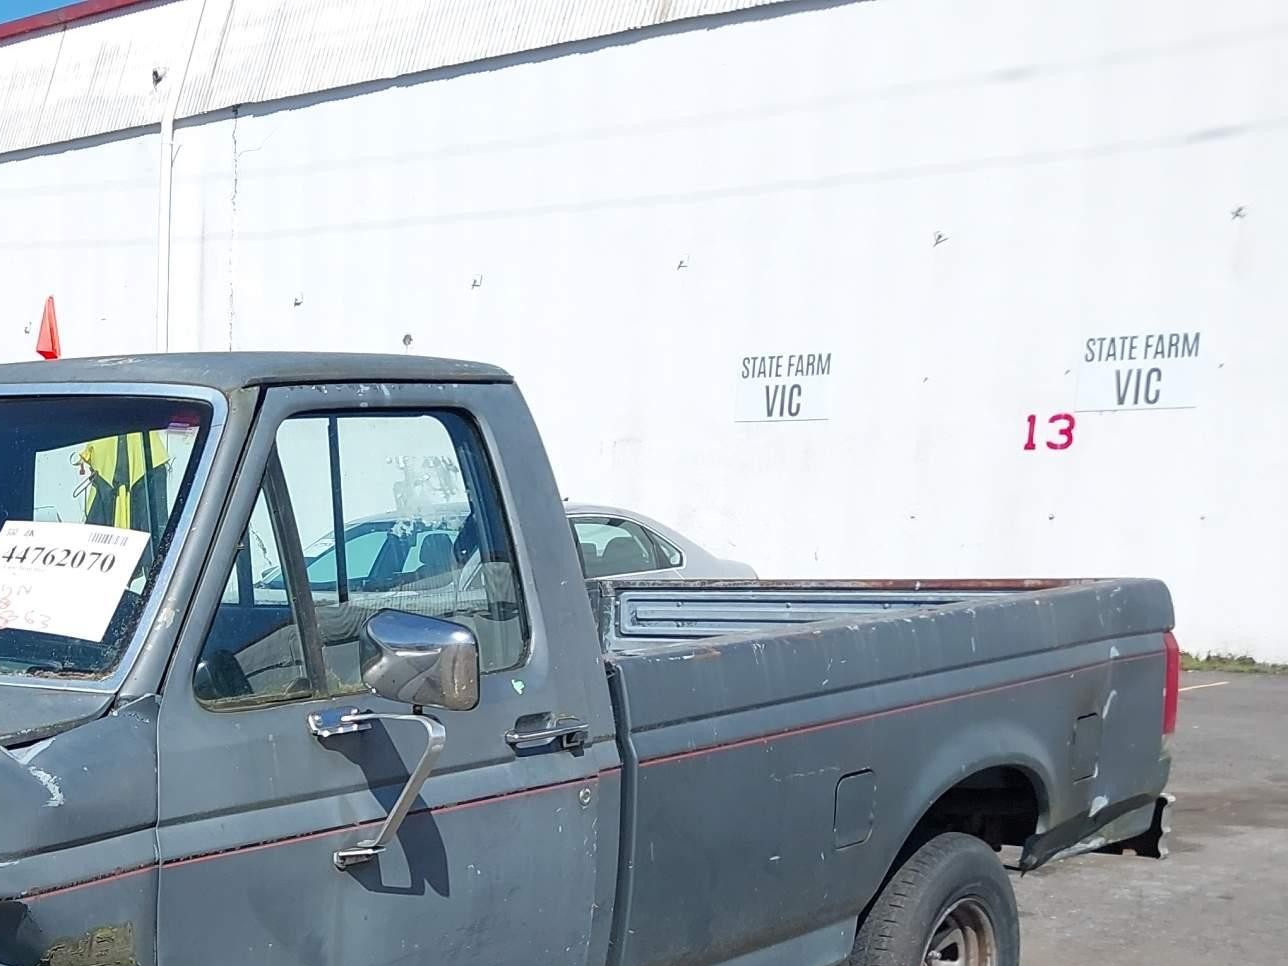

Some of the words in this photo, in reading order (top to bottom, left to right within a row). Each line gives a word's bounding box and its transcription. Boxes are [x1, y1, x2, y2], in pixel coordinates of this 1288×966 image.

[1084, 336, 1138, 363] STATE
[1143, 332, 1200, 359] FARM
[741, 355, 783, 379] STATE
[787, 353, 831, 377] FARM
[765, 384, 802, 417] VIC
[1114, 368, 1162, 405] VIC
[1023, 413, 1076, 450] 13
[2, 545, 116, 573] 44762070
